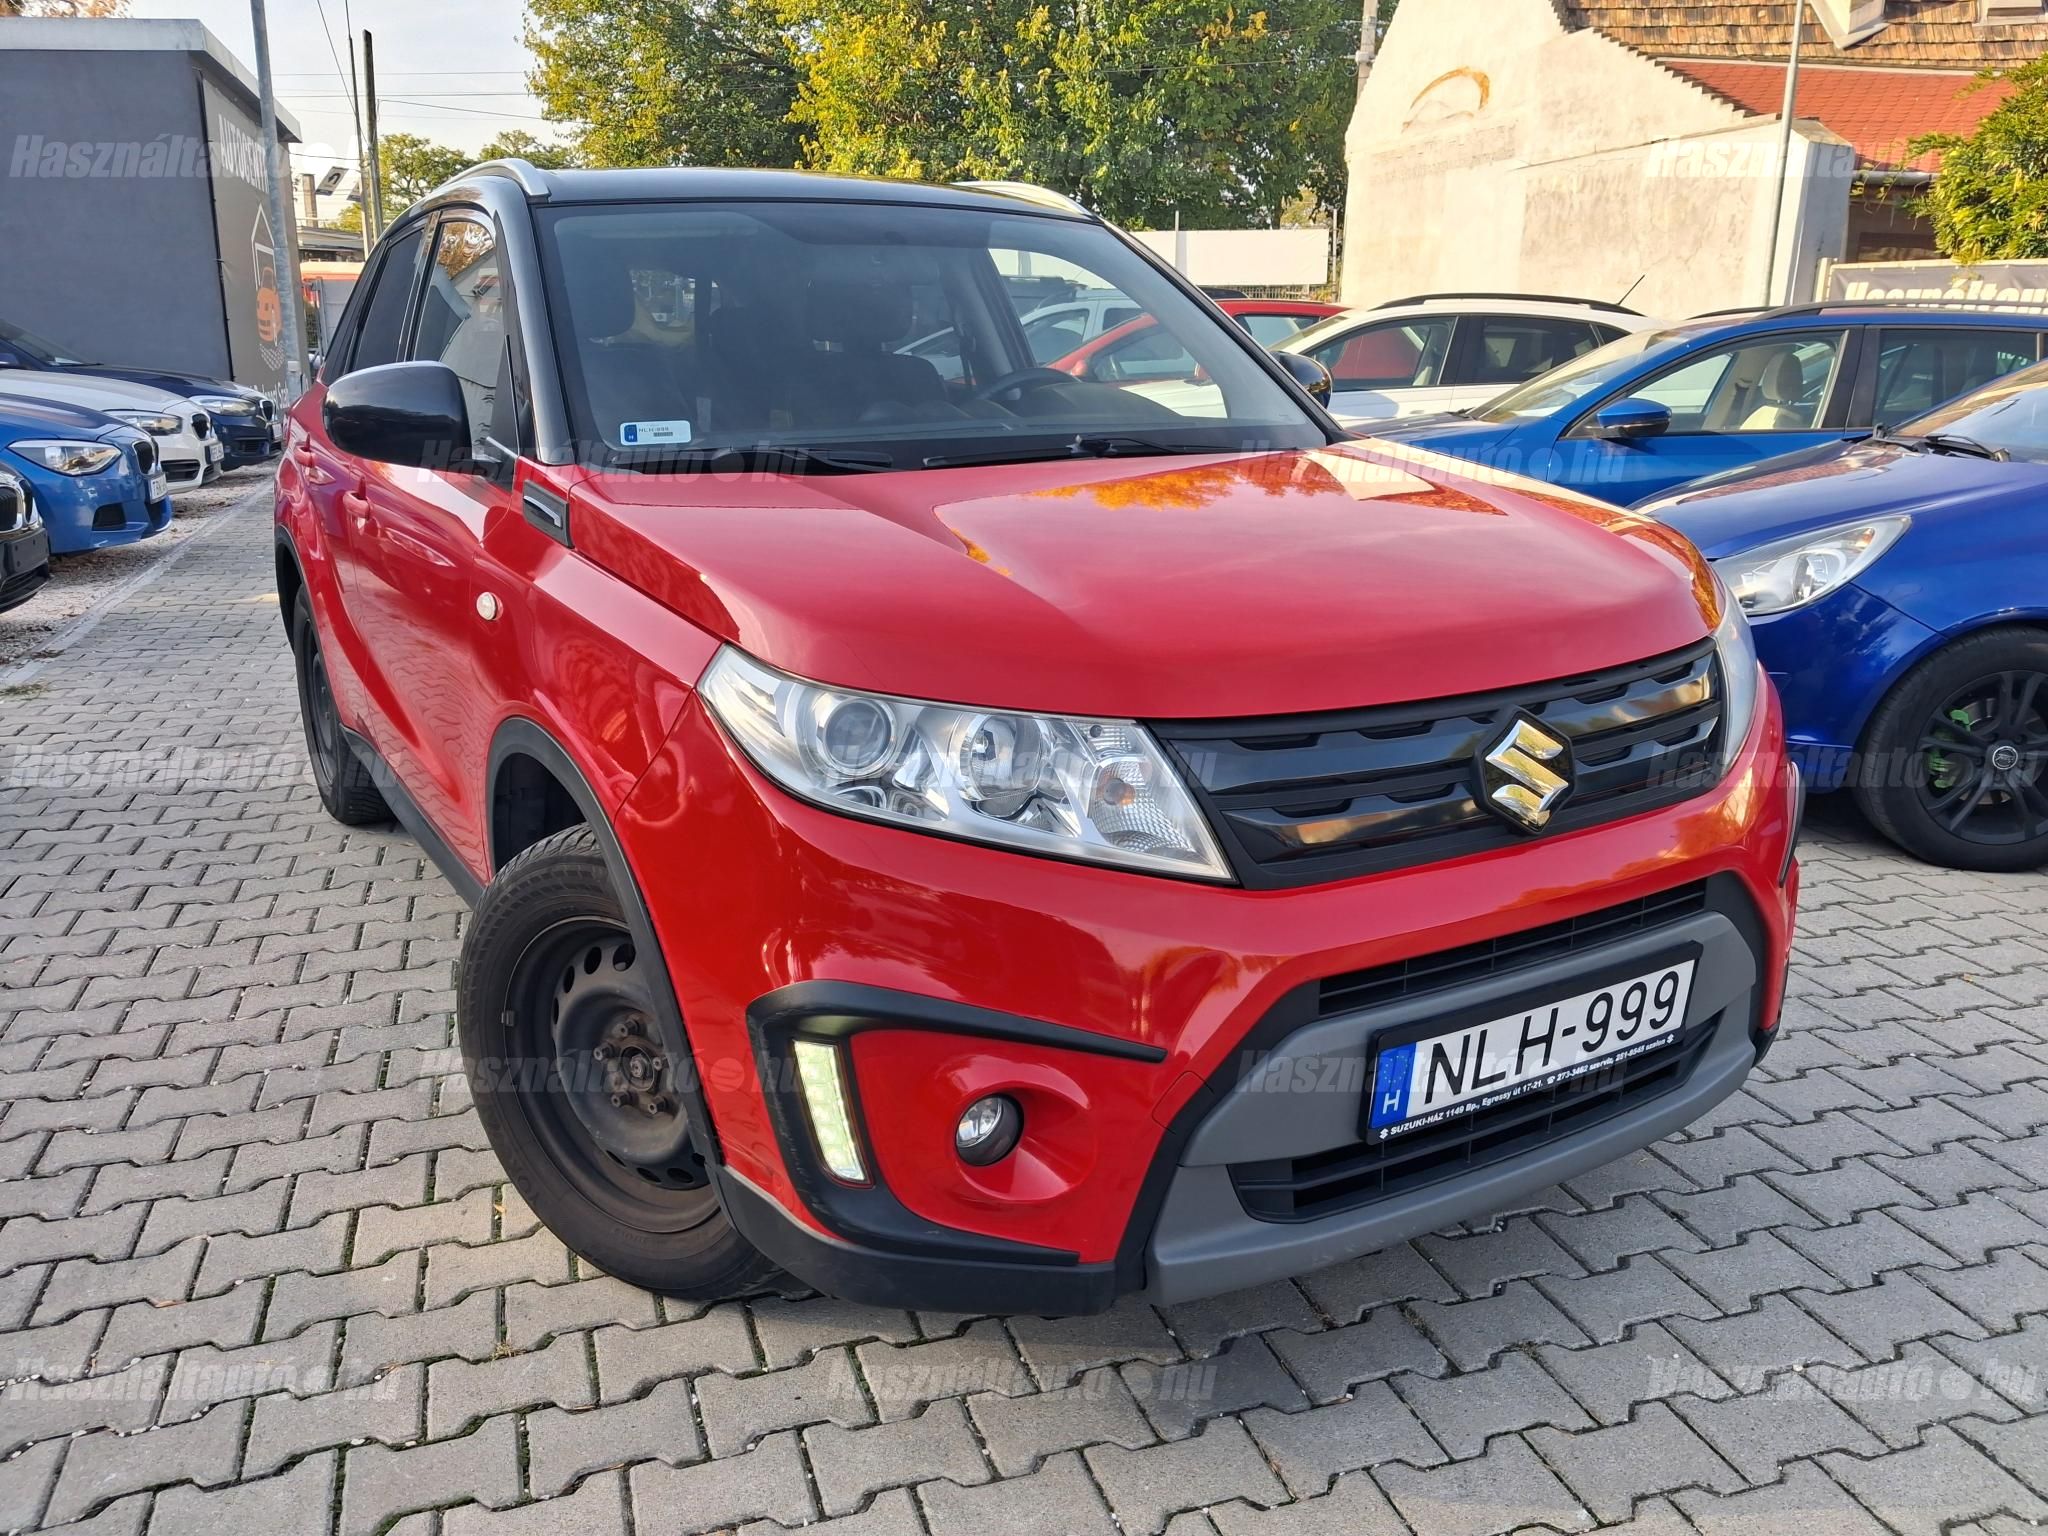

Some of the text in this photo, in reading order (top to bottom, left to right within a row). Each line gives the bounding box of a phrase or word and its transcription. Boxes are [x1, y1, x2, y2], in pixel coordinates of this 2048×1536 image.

[1425, 970, 1680, 1105] NLH-999
[1382, 1089, 1401, 1114] H
[1390, 1112, 1444, 1135] SUZUKI-HÁZ
[1445, 1105, 1465, 1118] 1149
[1482, 1090, 1512, 1106] Egressy
